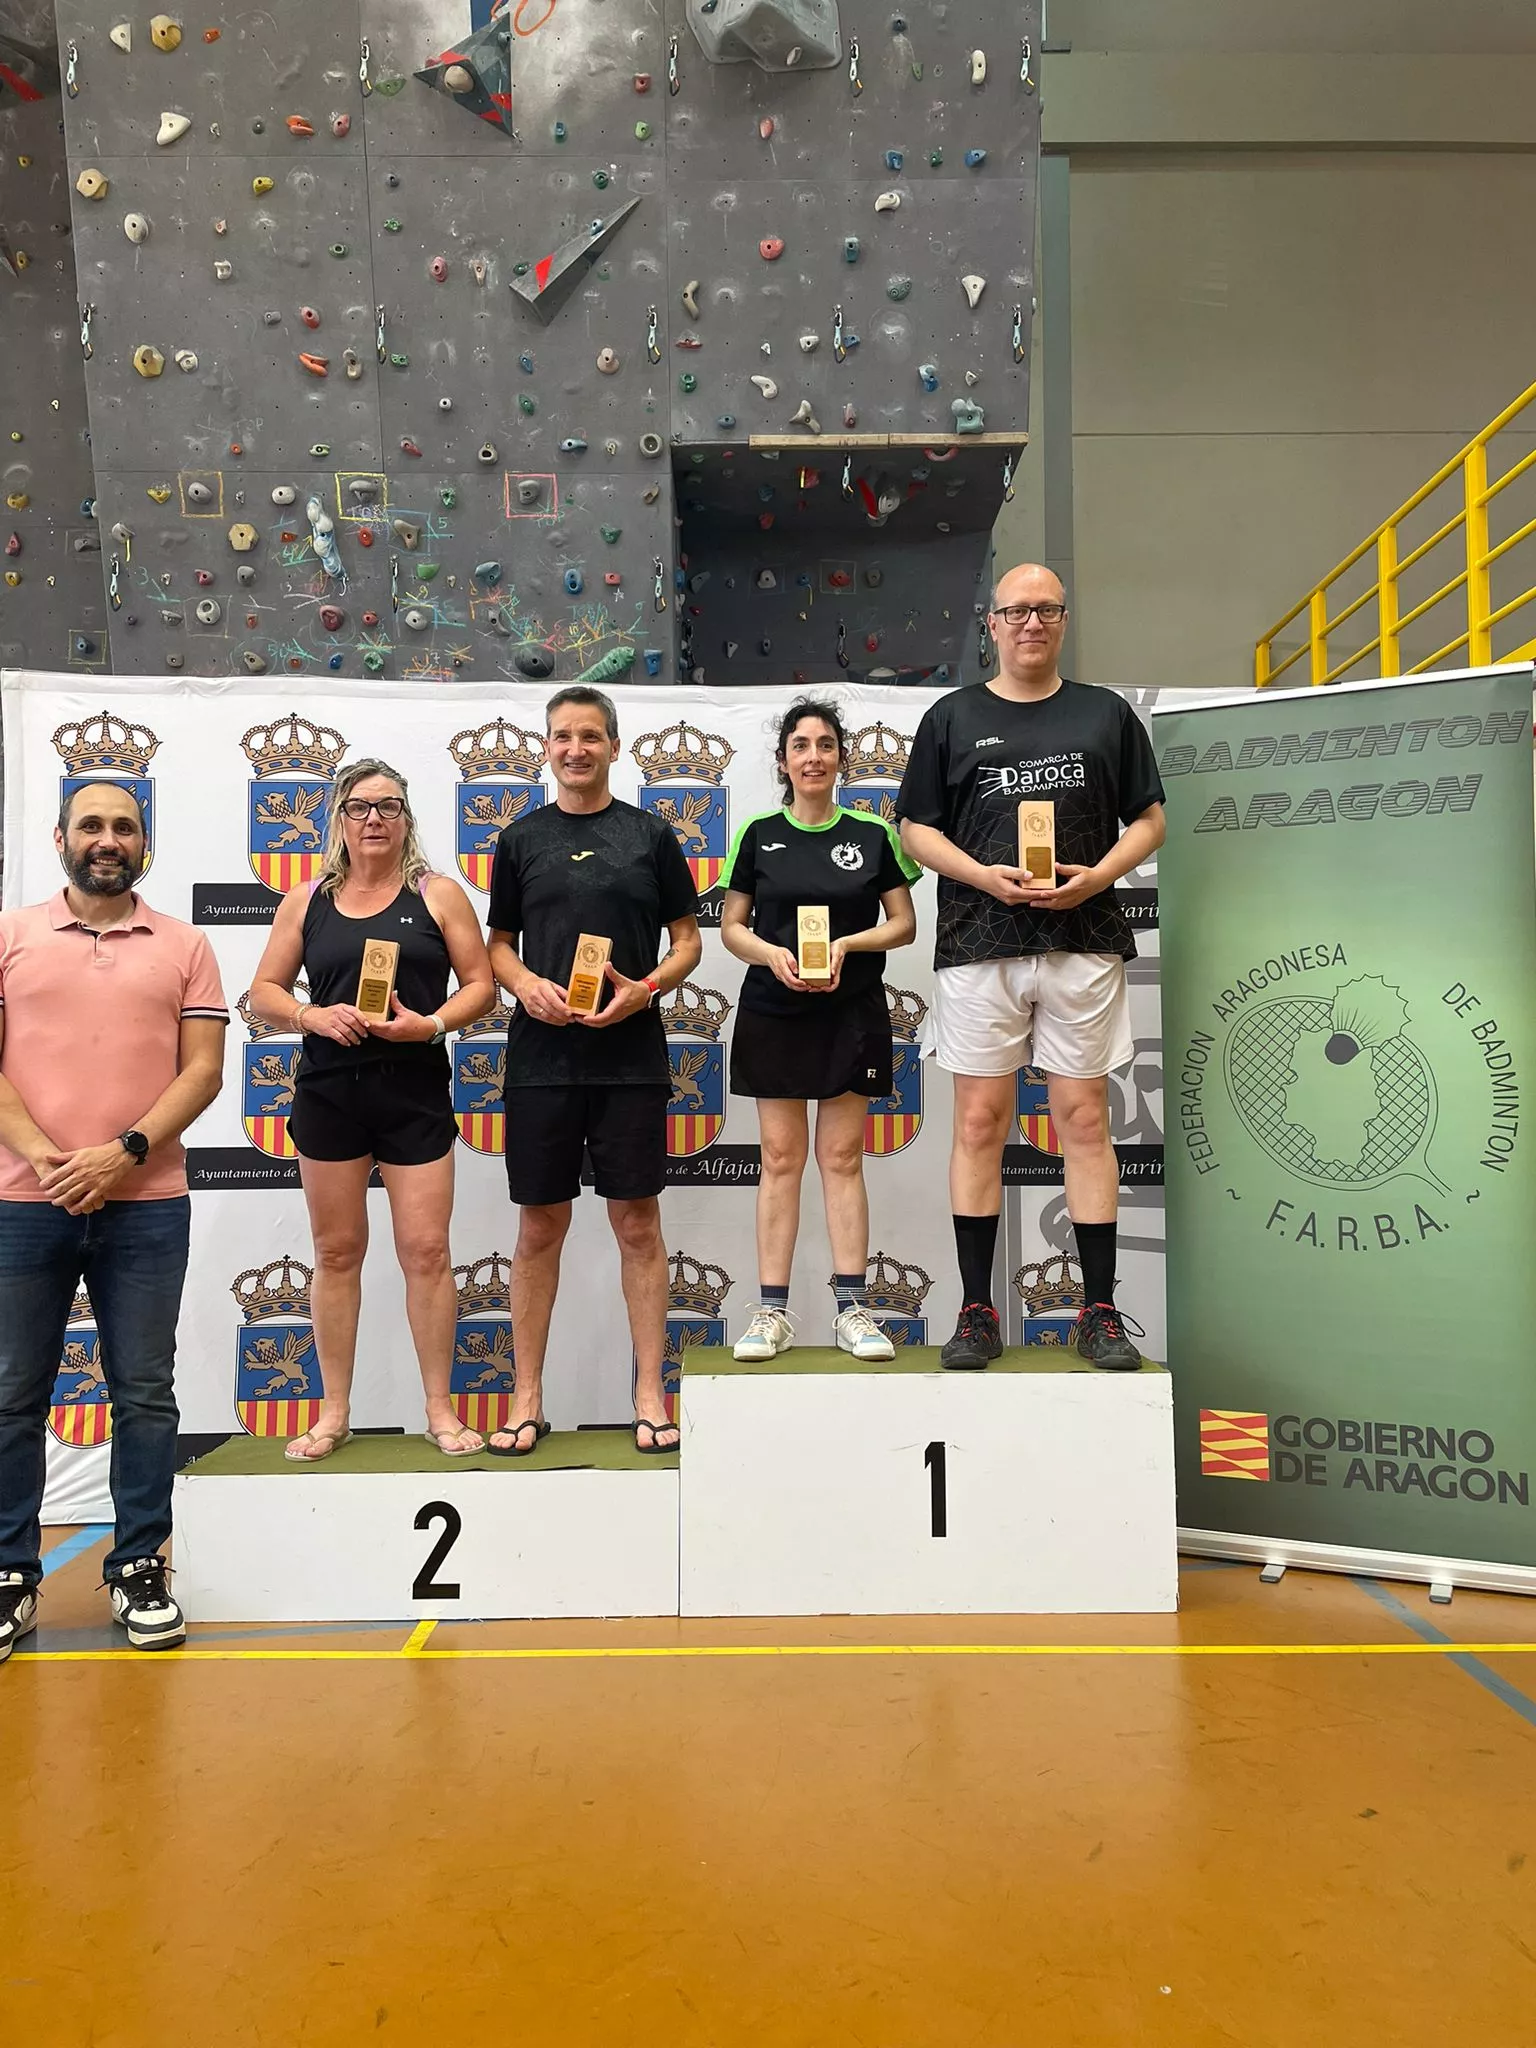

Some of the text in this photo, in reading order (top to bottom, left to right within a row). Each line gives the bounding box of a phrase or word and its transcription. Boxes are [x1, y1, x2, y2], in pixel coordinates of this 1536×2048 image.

[438, 516, 448, 529] 5
[975, 736, 1005, 749] RSL
[1159, 709, 1529, 778] BADMINTON
[1018, 752, 1084, 769] COMARCA DE
[1001, 763, 1085, 788] Daroca
[1002, 779, 1086, 796] BADMINTON
[1193, 774, 1483, 834] ARAGON
[202, 904, 276, 917] Ayuntamien
[1180, 943, 1520, 1176] FEDERACION ARAGONESA DE BADMINTON
[194, 1166, 298, 1182] Ayuntamiento de
[675, 1164, 689, 1176] de
[693, 1157, 763, 1181] Alfajar
[1001, 1165, 1056, 1176] ntamiento
[1273, 1414, 1495, 1464] GOBIERNO
[924, 1441, 947, 1538] 1
[1274, 1450, 1529, 1506] DE ARAGON
[412, 1500, 462, 1600] 2
